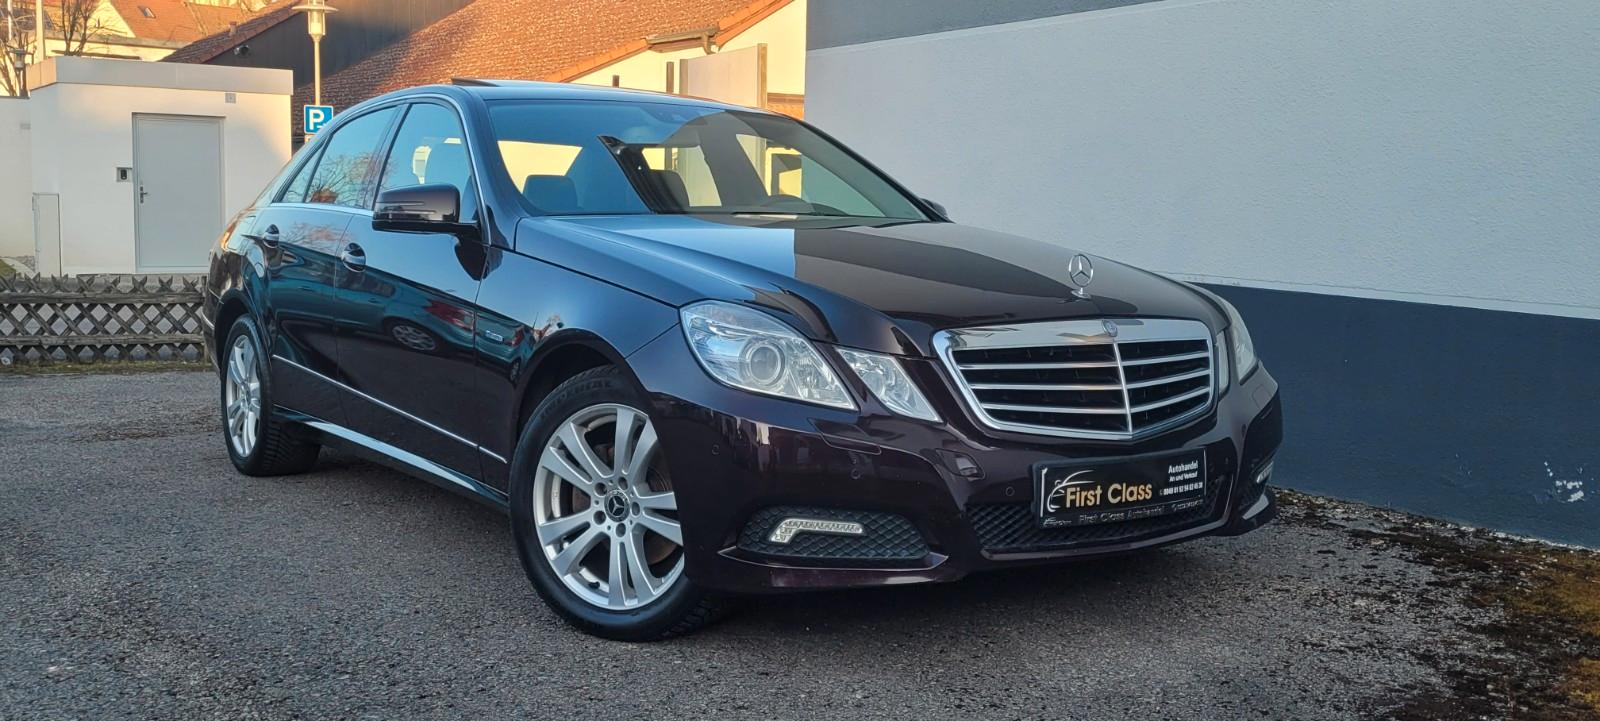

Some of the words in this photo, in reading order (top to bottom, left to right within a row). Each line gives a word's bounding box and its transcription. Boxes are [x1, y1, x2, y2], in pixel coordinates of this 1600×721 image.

[309, 109, 324, 130] P
[1168, 460, 1198, 474] Autohandel
[1066, 485, 1102, 508] First
[1107, 482, 1153, 504] Class
[1100, 511, 1125, 522] Class
